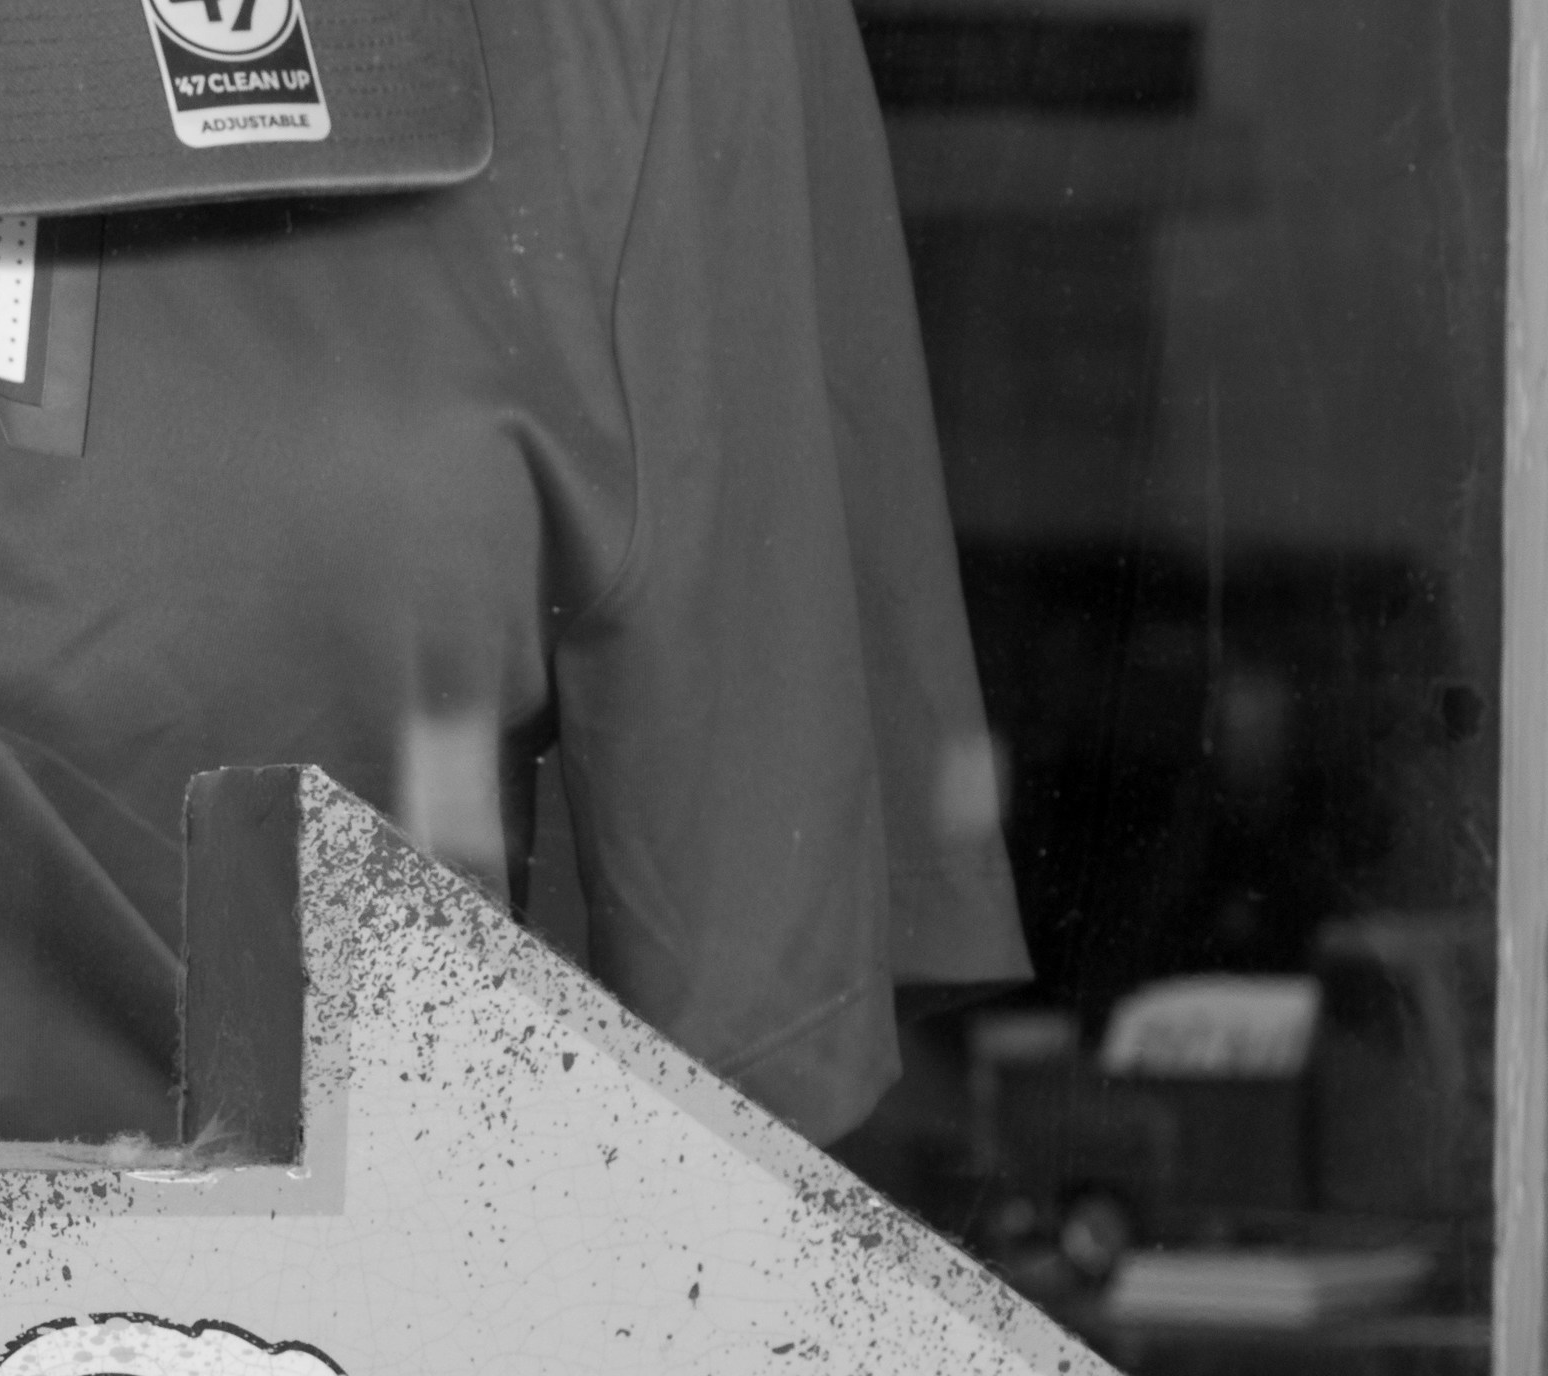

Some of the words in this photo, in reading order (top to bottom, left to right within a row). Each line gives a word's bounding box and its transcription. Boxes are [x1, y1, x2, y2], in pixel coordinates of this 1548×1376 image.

[208, 70, 280, 93] CLEAN
[282, 68, 311, 91] UP
[202, 114, 310, 133] ADJUSTABLE
